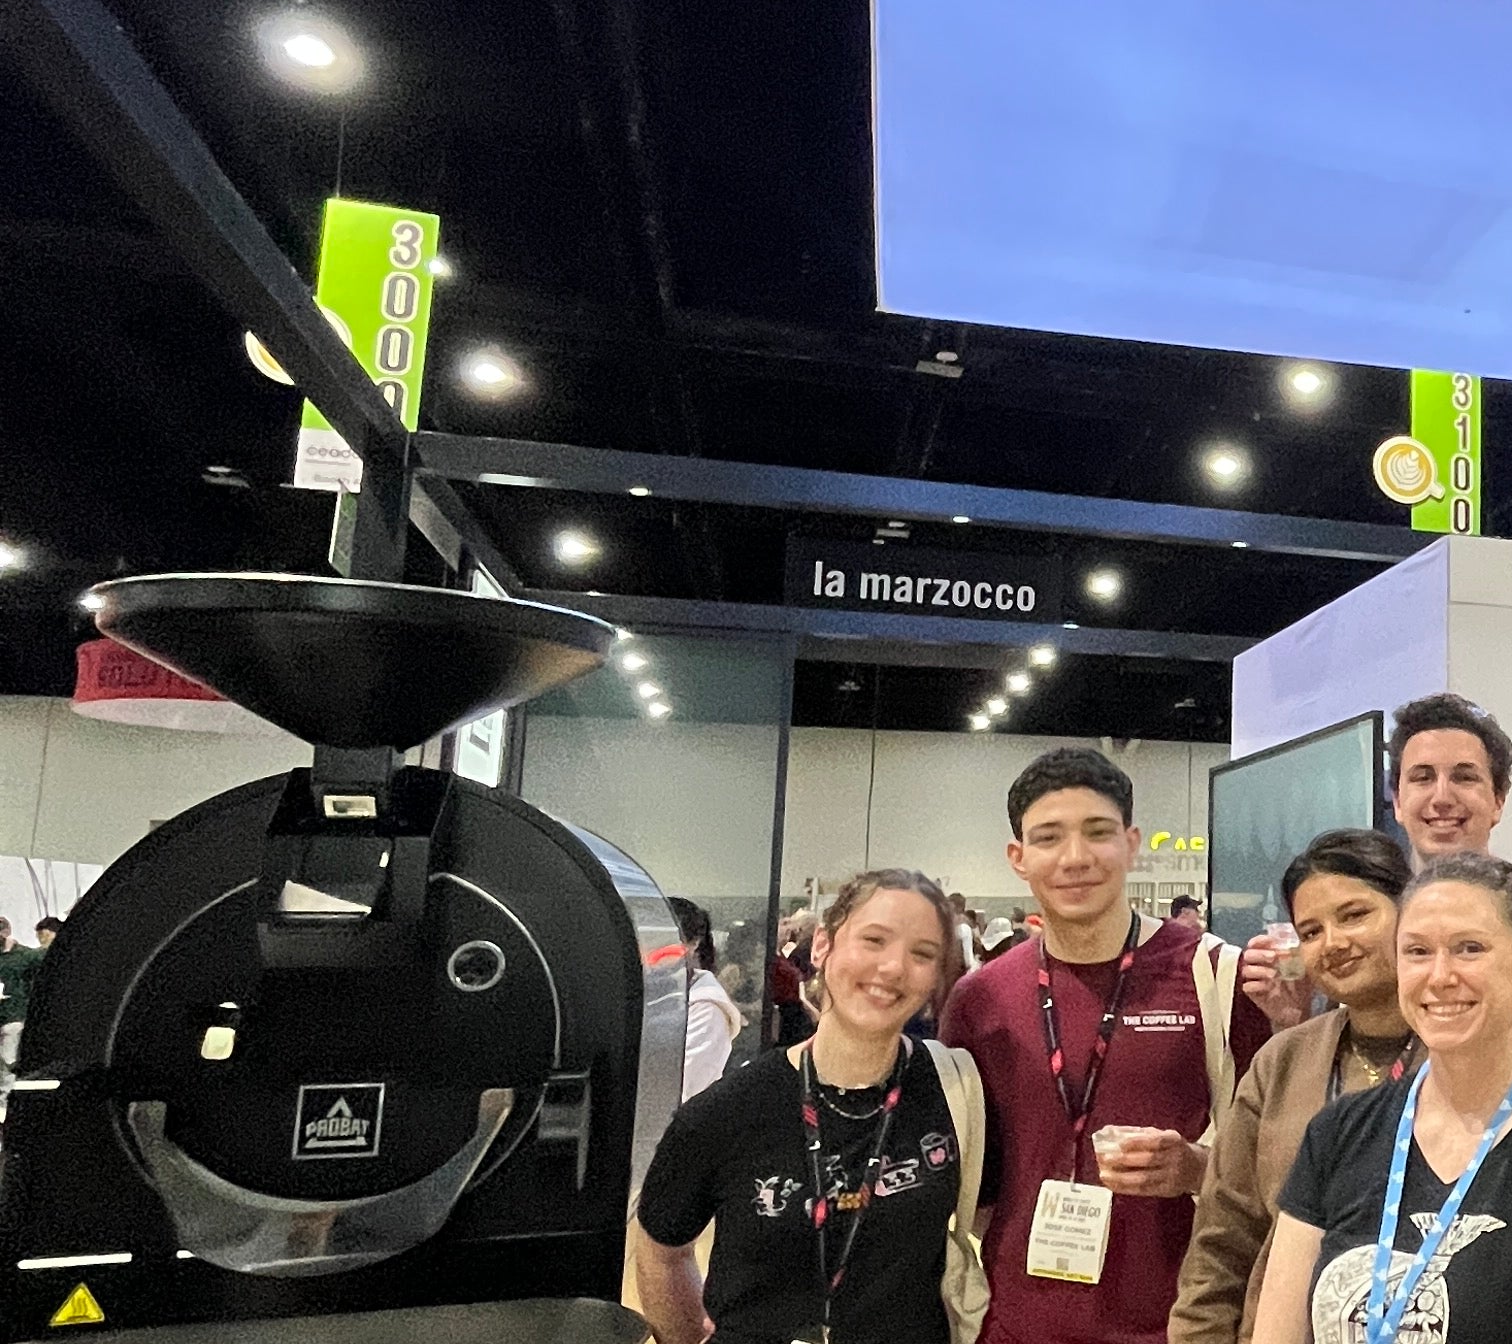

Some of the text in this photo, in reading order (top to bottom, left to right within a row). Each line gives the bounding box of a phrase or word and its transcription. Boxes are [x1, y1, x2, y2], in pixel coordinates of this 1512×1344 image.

[1451, 373, 1473, 534] 3100
[813, 560, 1036, 612] la marzocco
[1178, 1015, 1196, 1025] LAB
[305, 1117, 370, 1137] PROBAT
[1076, 1205, 1101, 1219] DIEGO
